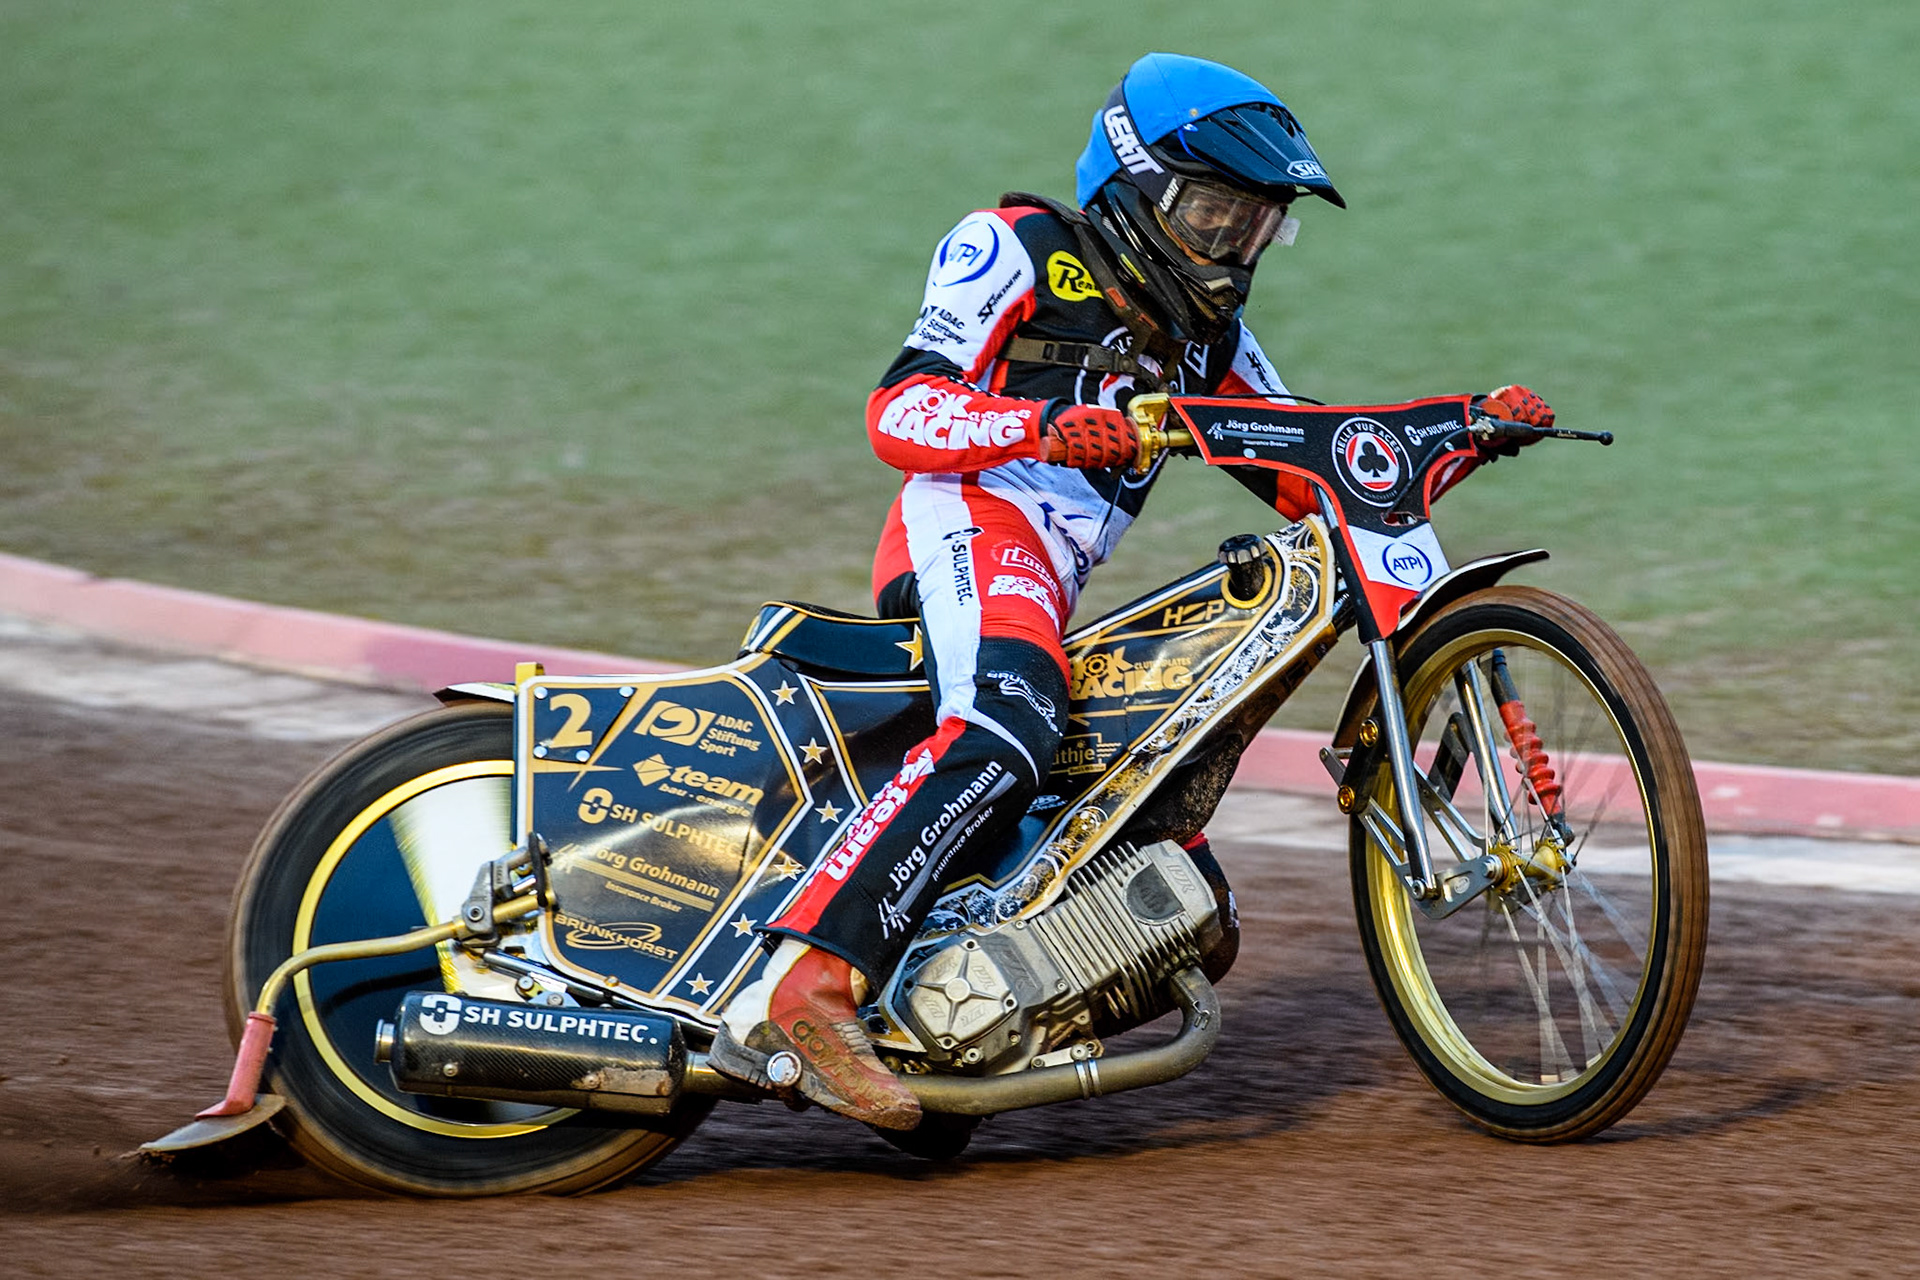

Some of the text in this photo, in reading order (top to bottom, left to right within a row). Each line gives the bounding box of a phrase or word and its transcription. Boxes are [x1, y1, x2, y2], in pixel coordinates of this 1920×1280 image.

[1103, 105, 1165, 175] LEATT
[938, 309, 966, 330] ADAC
[877, 395, 1026, 450] RACING
[1226, 419, 1305, 436] Jörg Grohmann
[1337, 422, 1401, 455] BELLE VUE ACES
[1392, 554, 1424, 571] ATPI
[1069, 665, 1193, 700] RACING
[549, 693, 593, 749] 2
[714, 715, 754, 733] ADAC
[698, 738, 737, 757] Sport
[706, 728, 762, 752] Stiftung
[658, 783, 686, 797] bau
[670, 764, 764, 806] team
[609, 803, 638, 824] SH
[888, 760, 1003, 891] Jörg Grohmann
[964, 806, 995, 838] Broker
[825, 786, 908, 881] team
[628, 856, 721, 899] Grohmann
[554, 912, 679, 960] BRUNKHORST
[462, 1005, 500, 1026] SH
